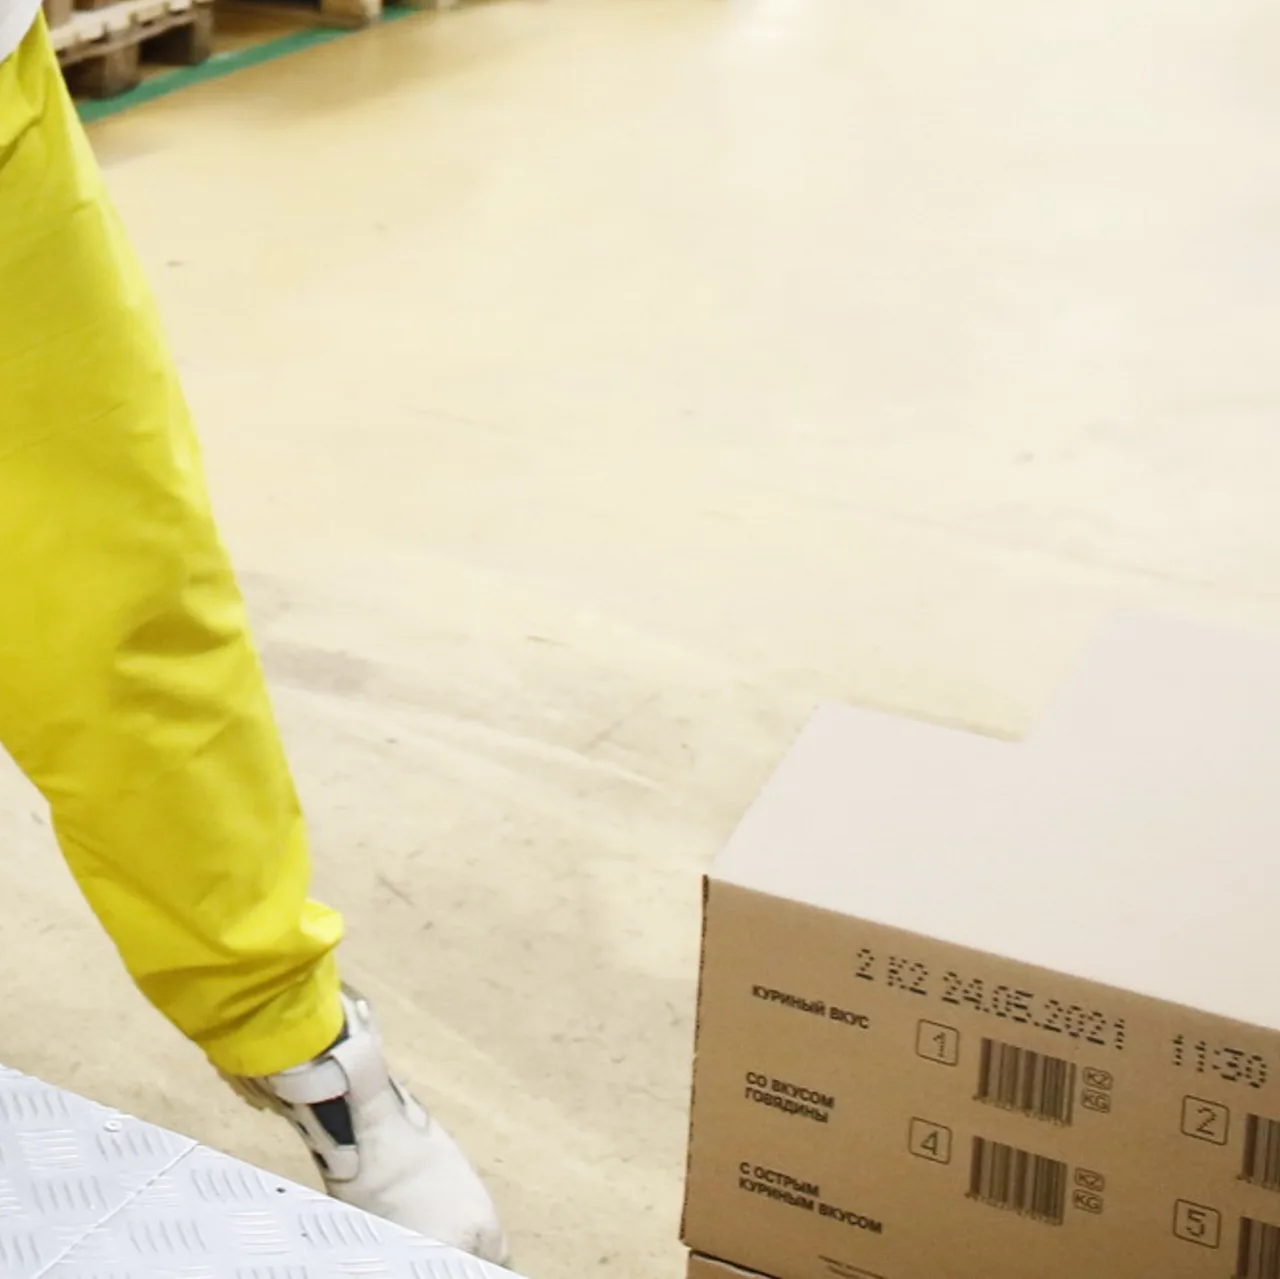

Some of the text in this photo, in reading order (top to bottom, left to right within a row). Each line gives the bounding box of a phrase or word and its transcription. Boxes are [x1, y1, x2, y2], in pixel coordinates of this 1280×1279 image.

[752, 984, 870, 1030] КУРИНЫЙ ВКУС
[855, 949, 875, 981] 2
[941, 971, 1125, 1051] 24.05.2021
[932, 1031, 947, 1058] 1
[745, 1086, 829, 1122] ГОВЯДИНЫ
[746, 1071, 835, 1109] СО ВКУСОМ
[1195, 1106, 1218, 1136] 2
[920, 1130, 939, 1156] 4
[739, 1161, 820, 1197] С ОСТРЫМ
[739, 1176, 883, 1234] КУРИНЫМ ВКУСОМ
[1186, 1208, 1206, 1238] 5
